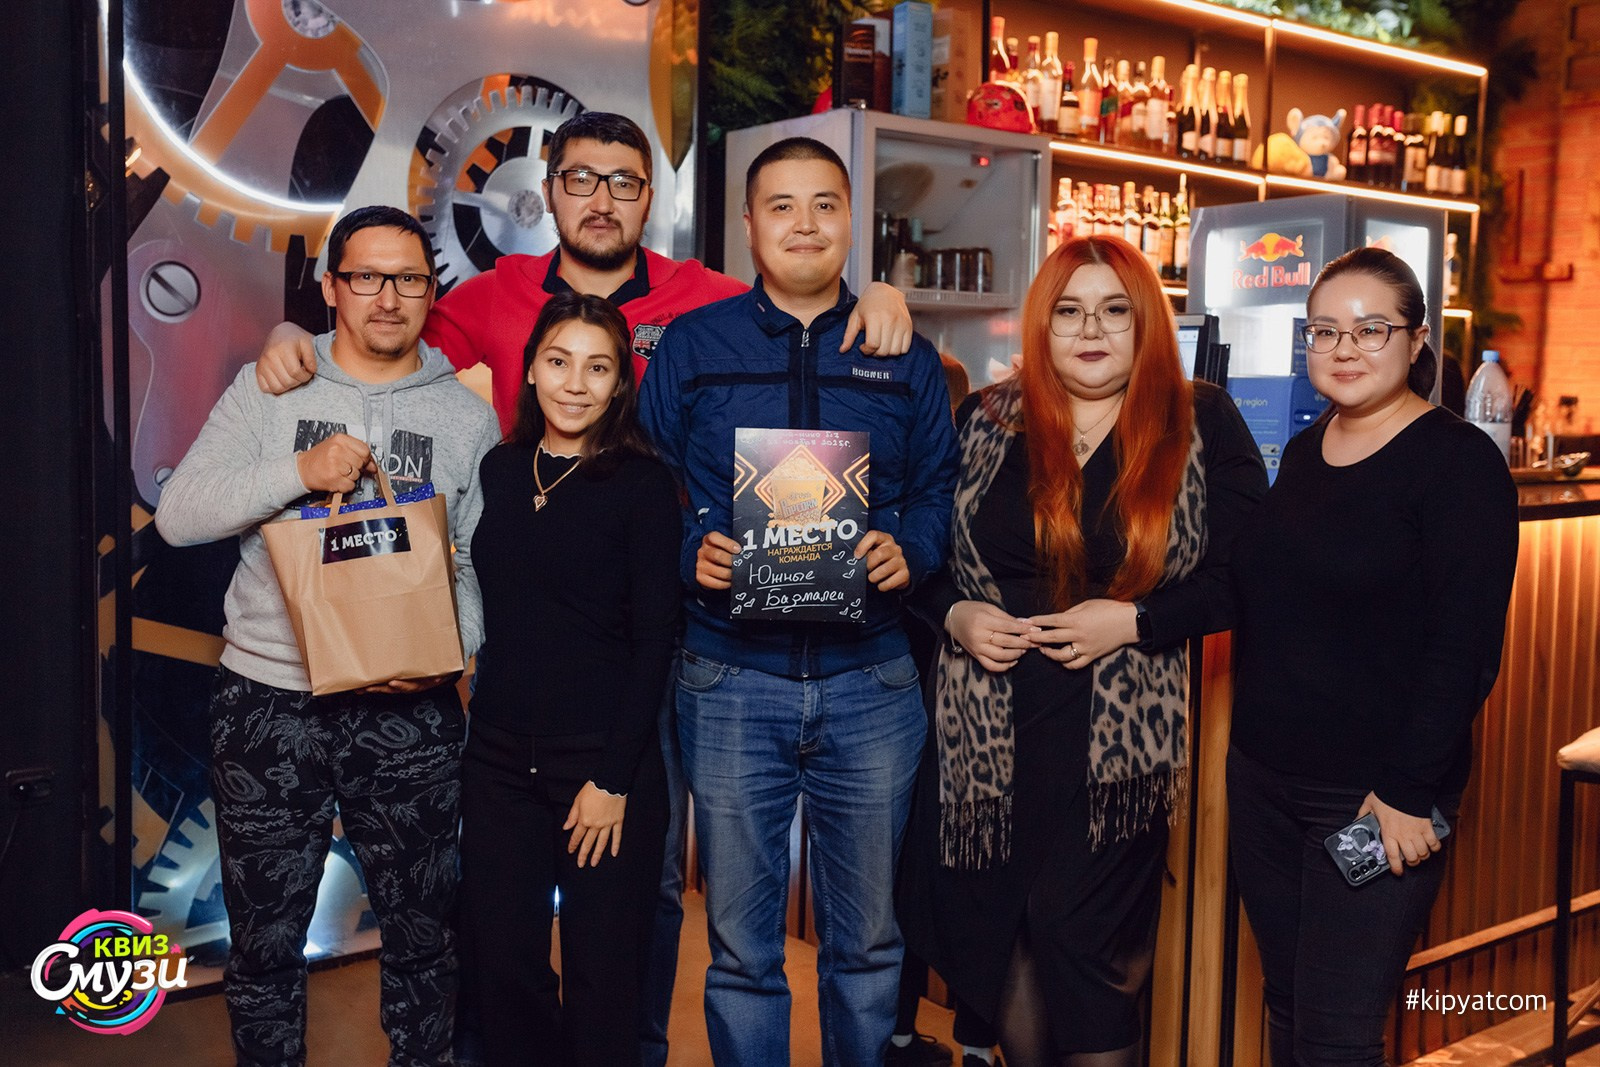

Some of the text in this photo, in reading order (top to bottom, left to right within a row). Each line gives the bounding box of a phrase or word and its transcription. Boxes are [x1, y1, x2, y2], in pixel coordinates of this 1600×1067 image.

[1232, 262, 1311, 289] Red Bull
[852, 367, 889, 380] BOGNER
[1243, 399, 1268, 408] region
[330, 530, 398, 552] 1 МЕСТО
[743, 518, 858, 551] 1 МЕСТО
[767, 542, 833, 557] НАГРАЖДАЕТСЯ
[778, 552, 821, 564] КОМАНДА
[749, 563, 815, 584] Южные
